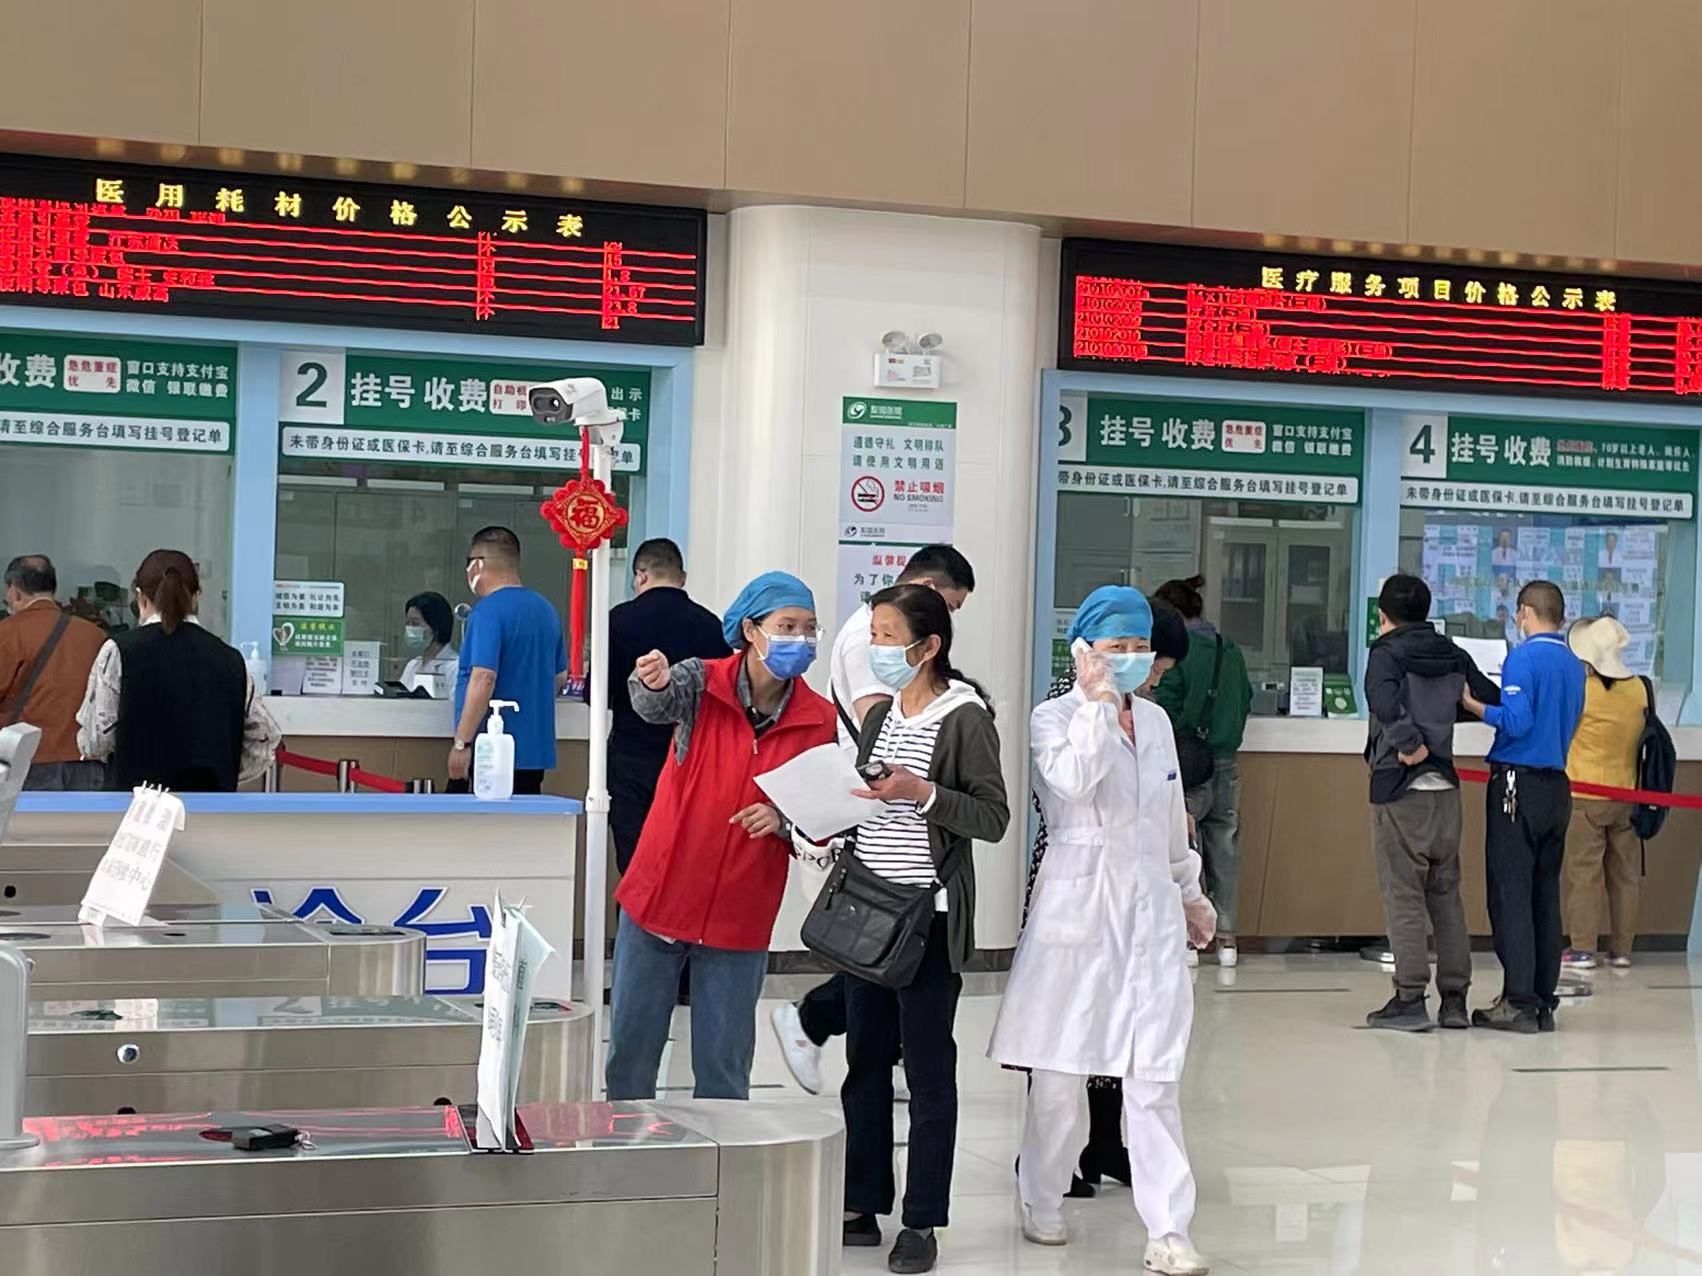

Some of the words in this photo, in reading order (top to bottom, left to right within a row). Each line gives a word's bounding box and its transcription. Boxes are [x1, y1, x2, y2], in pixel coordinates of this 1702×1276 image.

[95, 178, 584, 238] 医用耗材价格公示表
[1261, 266, 1617, 312] 医疗服务项目价格公示表
[126, 360, 229, 380] 窗口支持支付宝
[126, 378, 156, 395] 微信
[295, 361, 329, 408] 2
[350, 371, 488, 414] 挂号收费
[289, 434, 634, 464] 未带身份证或医保卡,请至综合服务台填写挂单
[1099, 414, 1217, 450] 挂号收费
[1409, 423, 1436, 465] 4
[1450, 431, 1552, 468] 挂号收费
[893, 493, 906, 502] NO
[894, 479, 944, 495] 禁止吸烟
[569, 498, 602, 528] 福
